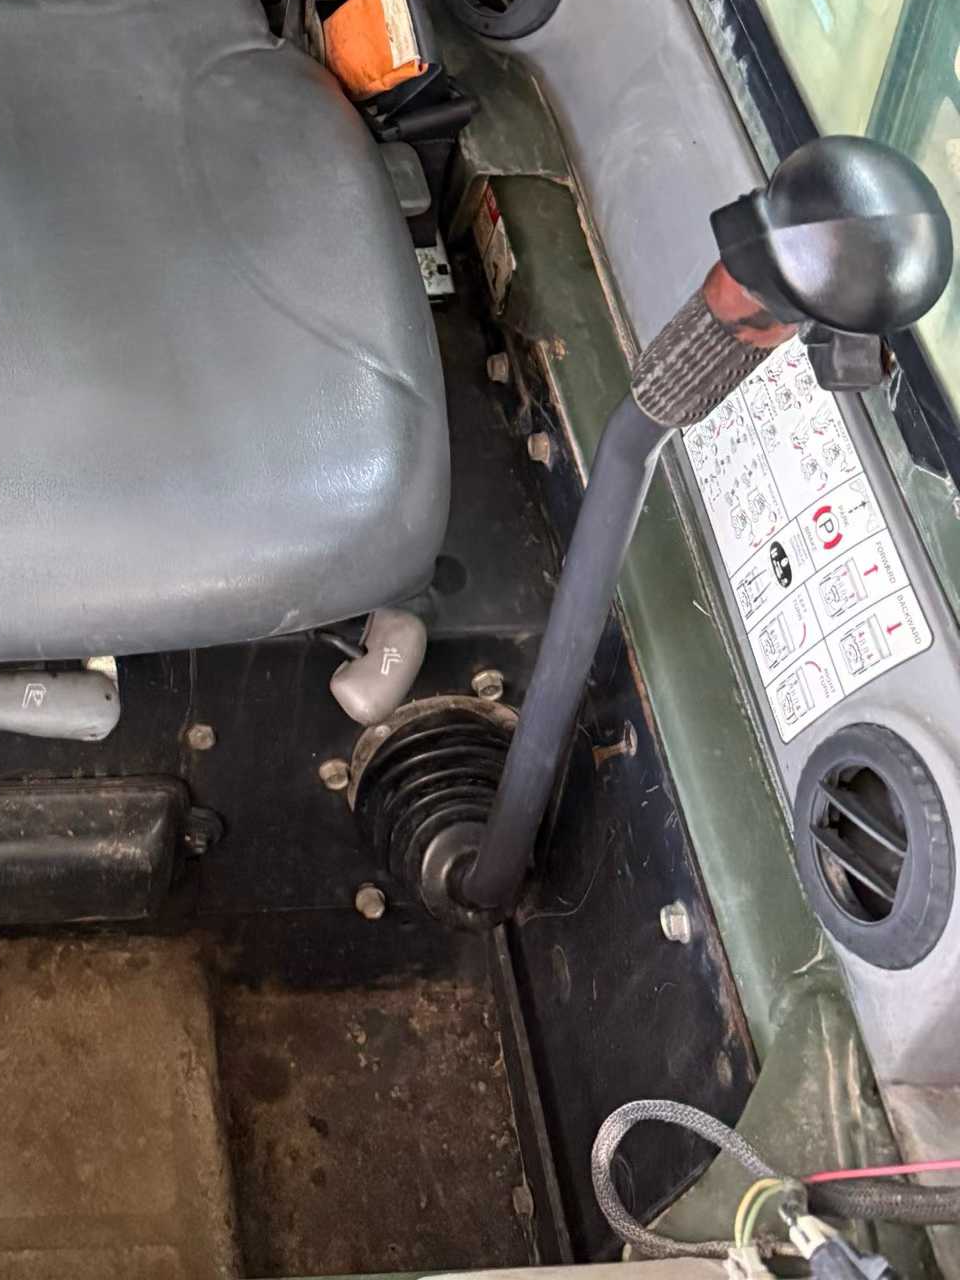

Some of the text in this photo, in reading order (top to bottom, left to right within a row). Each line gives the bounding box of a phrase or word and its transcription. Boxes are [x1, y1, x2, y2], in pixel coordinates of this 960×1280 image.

[819, 518, 834, 533] P
[876, 540, 896, 584] FORWARD
[897, 594, 921, 645] BACKWARD
